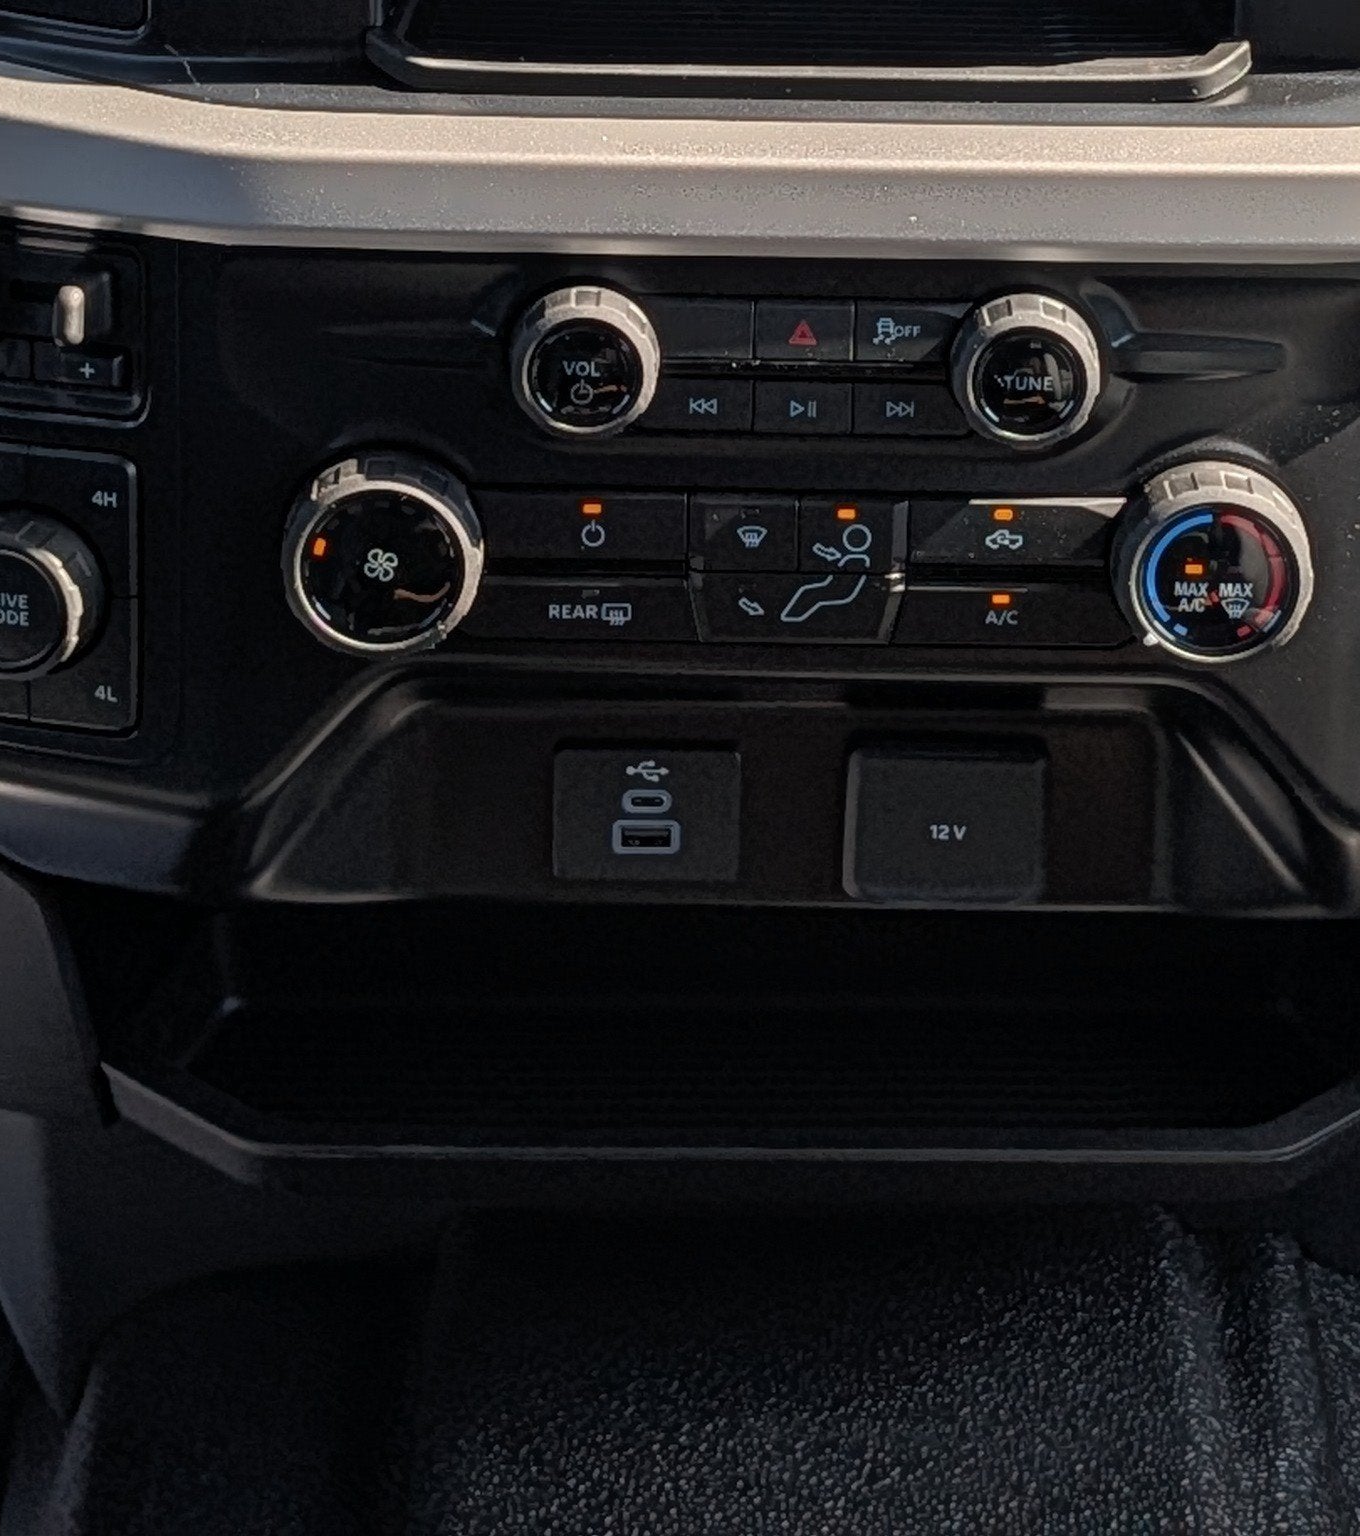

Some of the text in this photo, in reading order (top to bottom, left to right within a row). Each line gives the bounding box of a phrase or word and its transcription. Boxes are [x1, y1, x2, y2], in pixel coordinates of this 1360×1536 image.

[894, 322, 922, 340] OFF
[563, 360, 601, 379] VOL
[1004, 375, 1055, 393] TUNE
[91, 490, 118, 508] 4H
[1174, 581, 1210, 597] MAX
[1218, 582, 1254, 598] MAX
[548, 602, 599, 620] REAR
[1177, 597, 1206, 613] A/C
[985, 608, 1019, 627] A/C
[94, 684, 119, 703] 4L
[929, 824, 968, 841] 12 V
